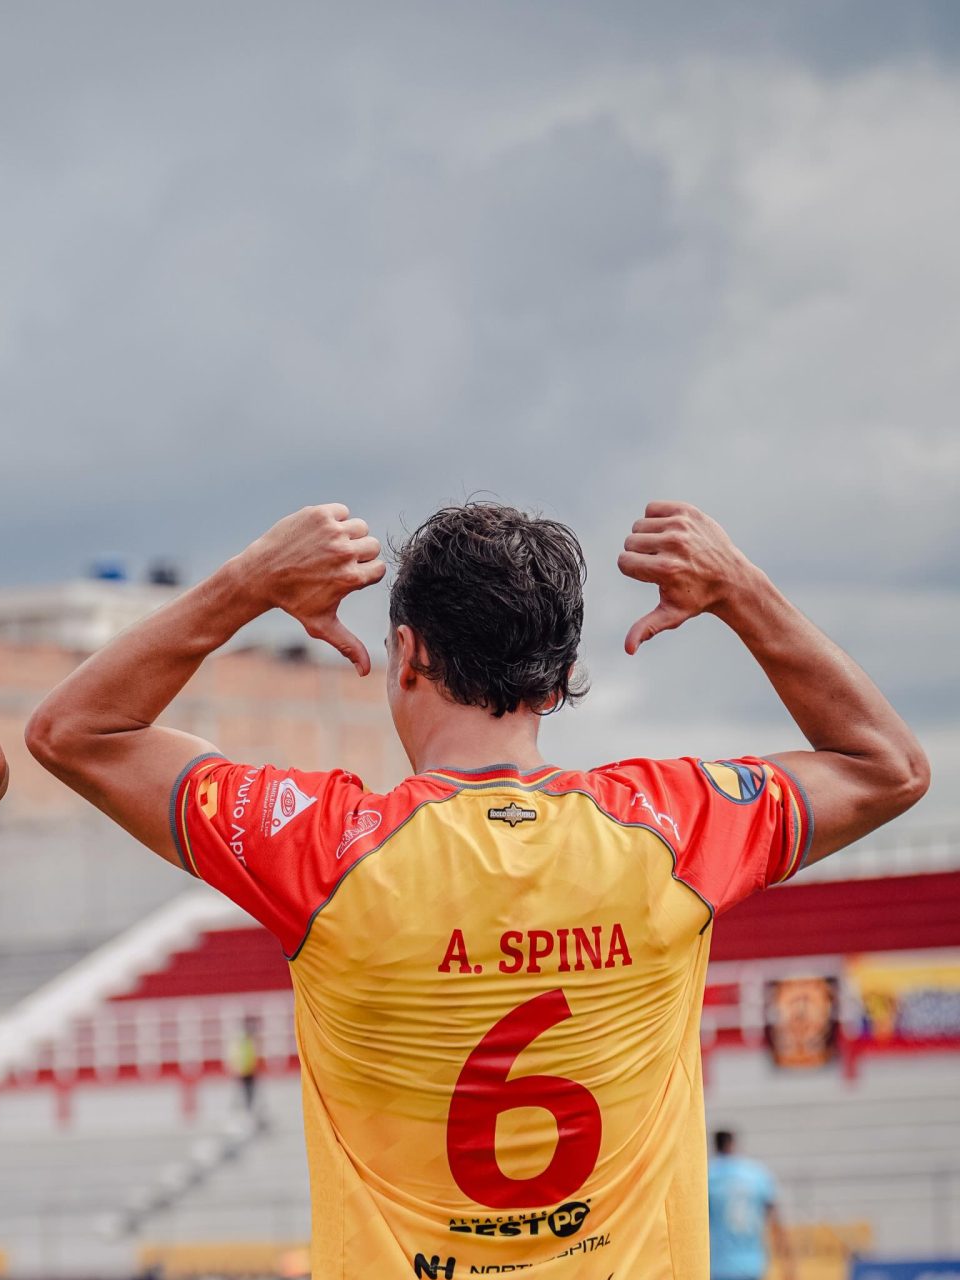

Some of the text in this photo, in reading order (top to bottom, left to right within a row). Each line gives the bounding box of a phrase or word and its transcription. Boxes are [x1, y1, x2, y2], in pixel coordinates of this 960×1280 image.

[438, 922, 632, 974] A. SPINA
[446, 988, 602, 1209] 6
[449, 1210, 548, 1225] ALMACENES
